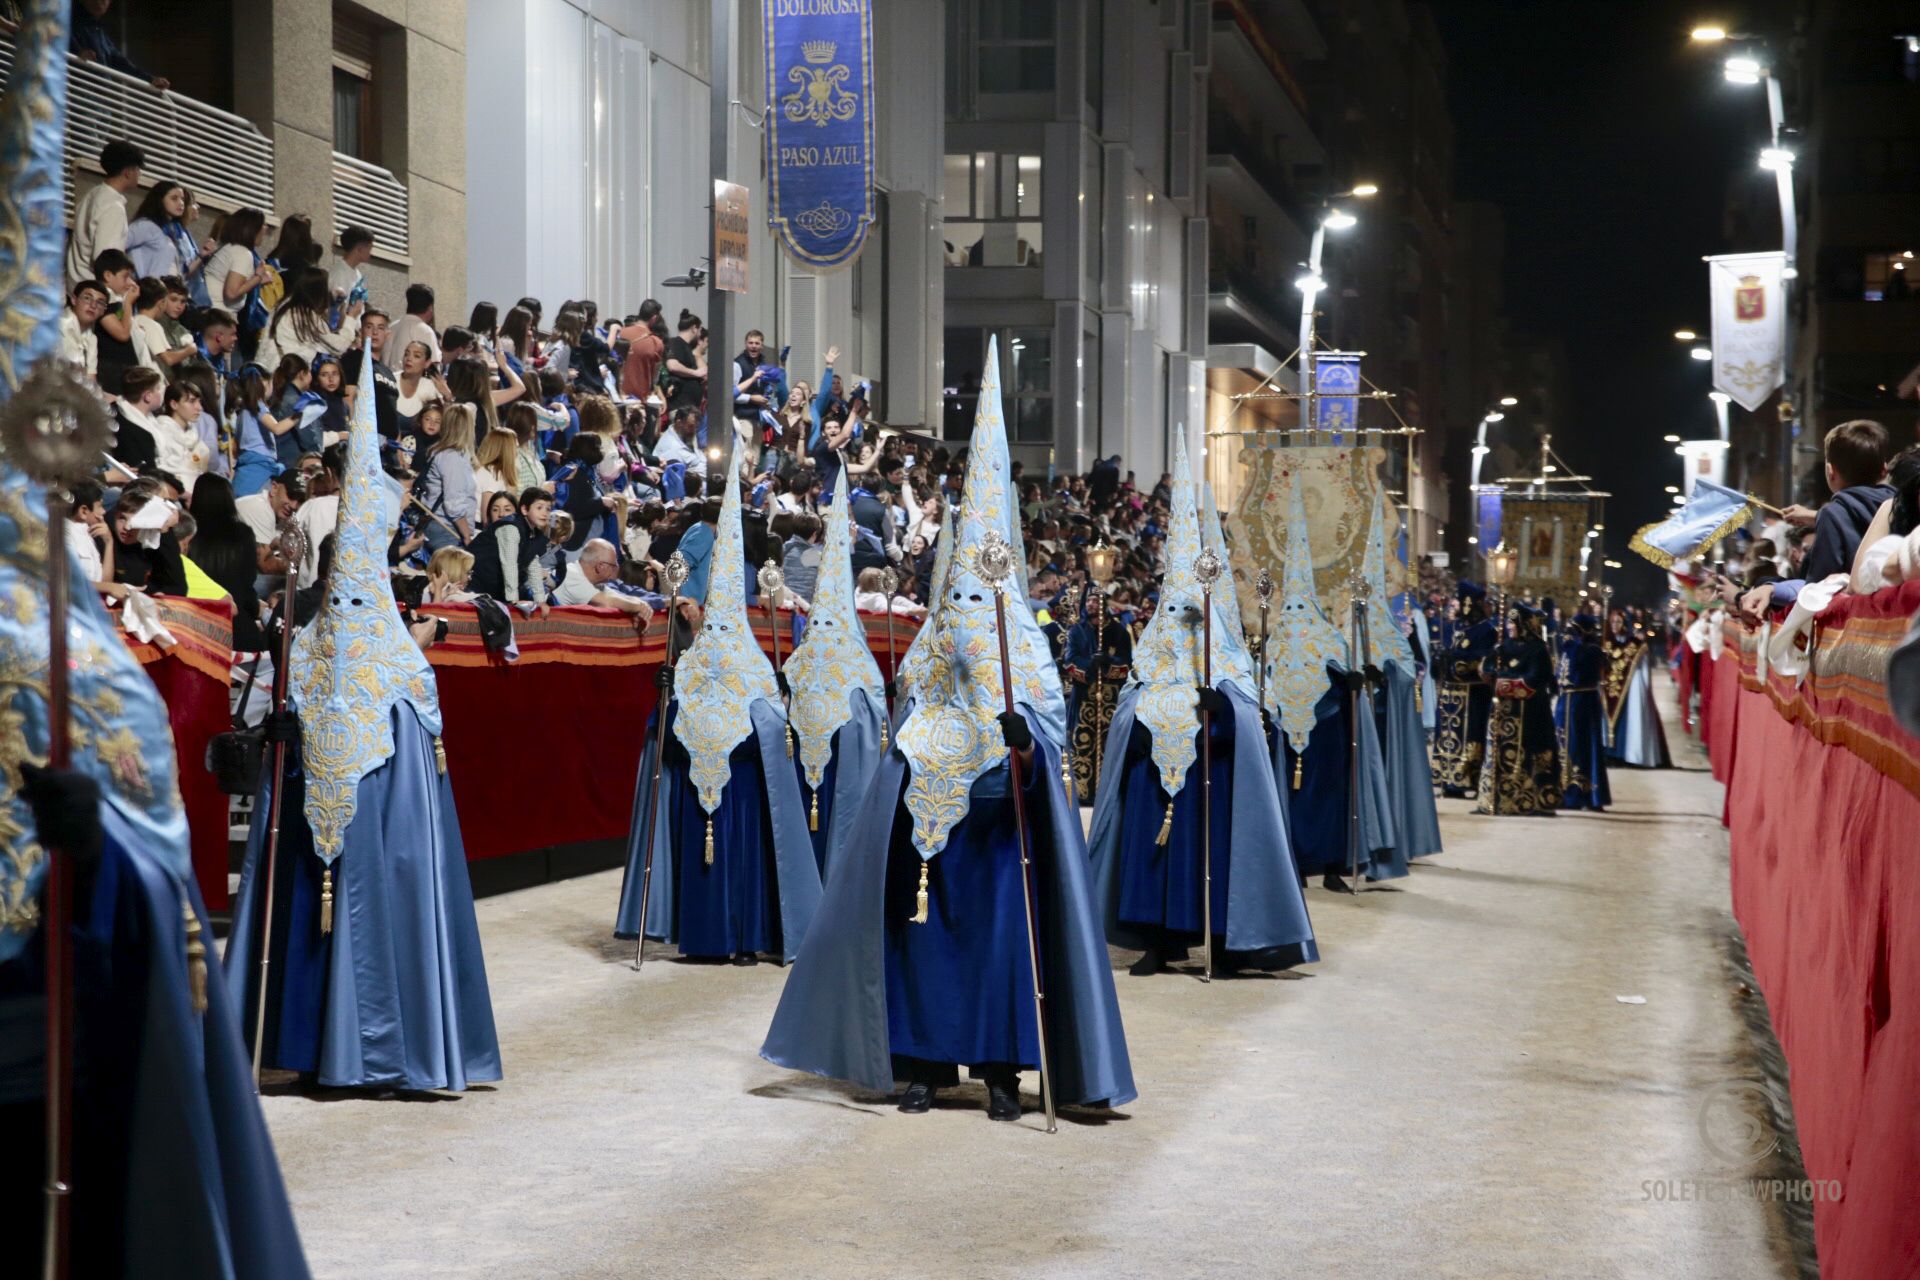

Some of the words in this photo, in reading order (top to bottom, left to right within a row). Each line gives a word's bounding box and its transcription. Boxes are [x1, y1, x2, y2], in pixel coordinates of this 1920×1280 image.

[777, 0, 860, 16] DOLOROSA
[781, 147, 819, 167] PASO
[822, 146, 861, 165] AZUL
